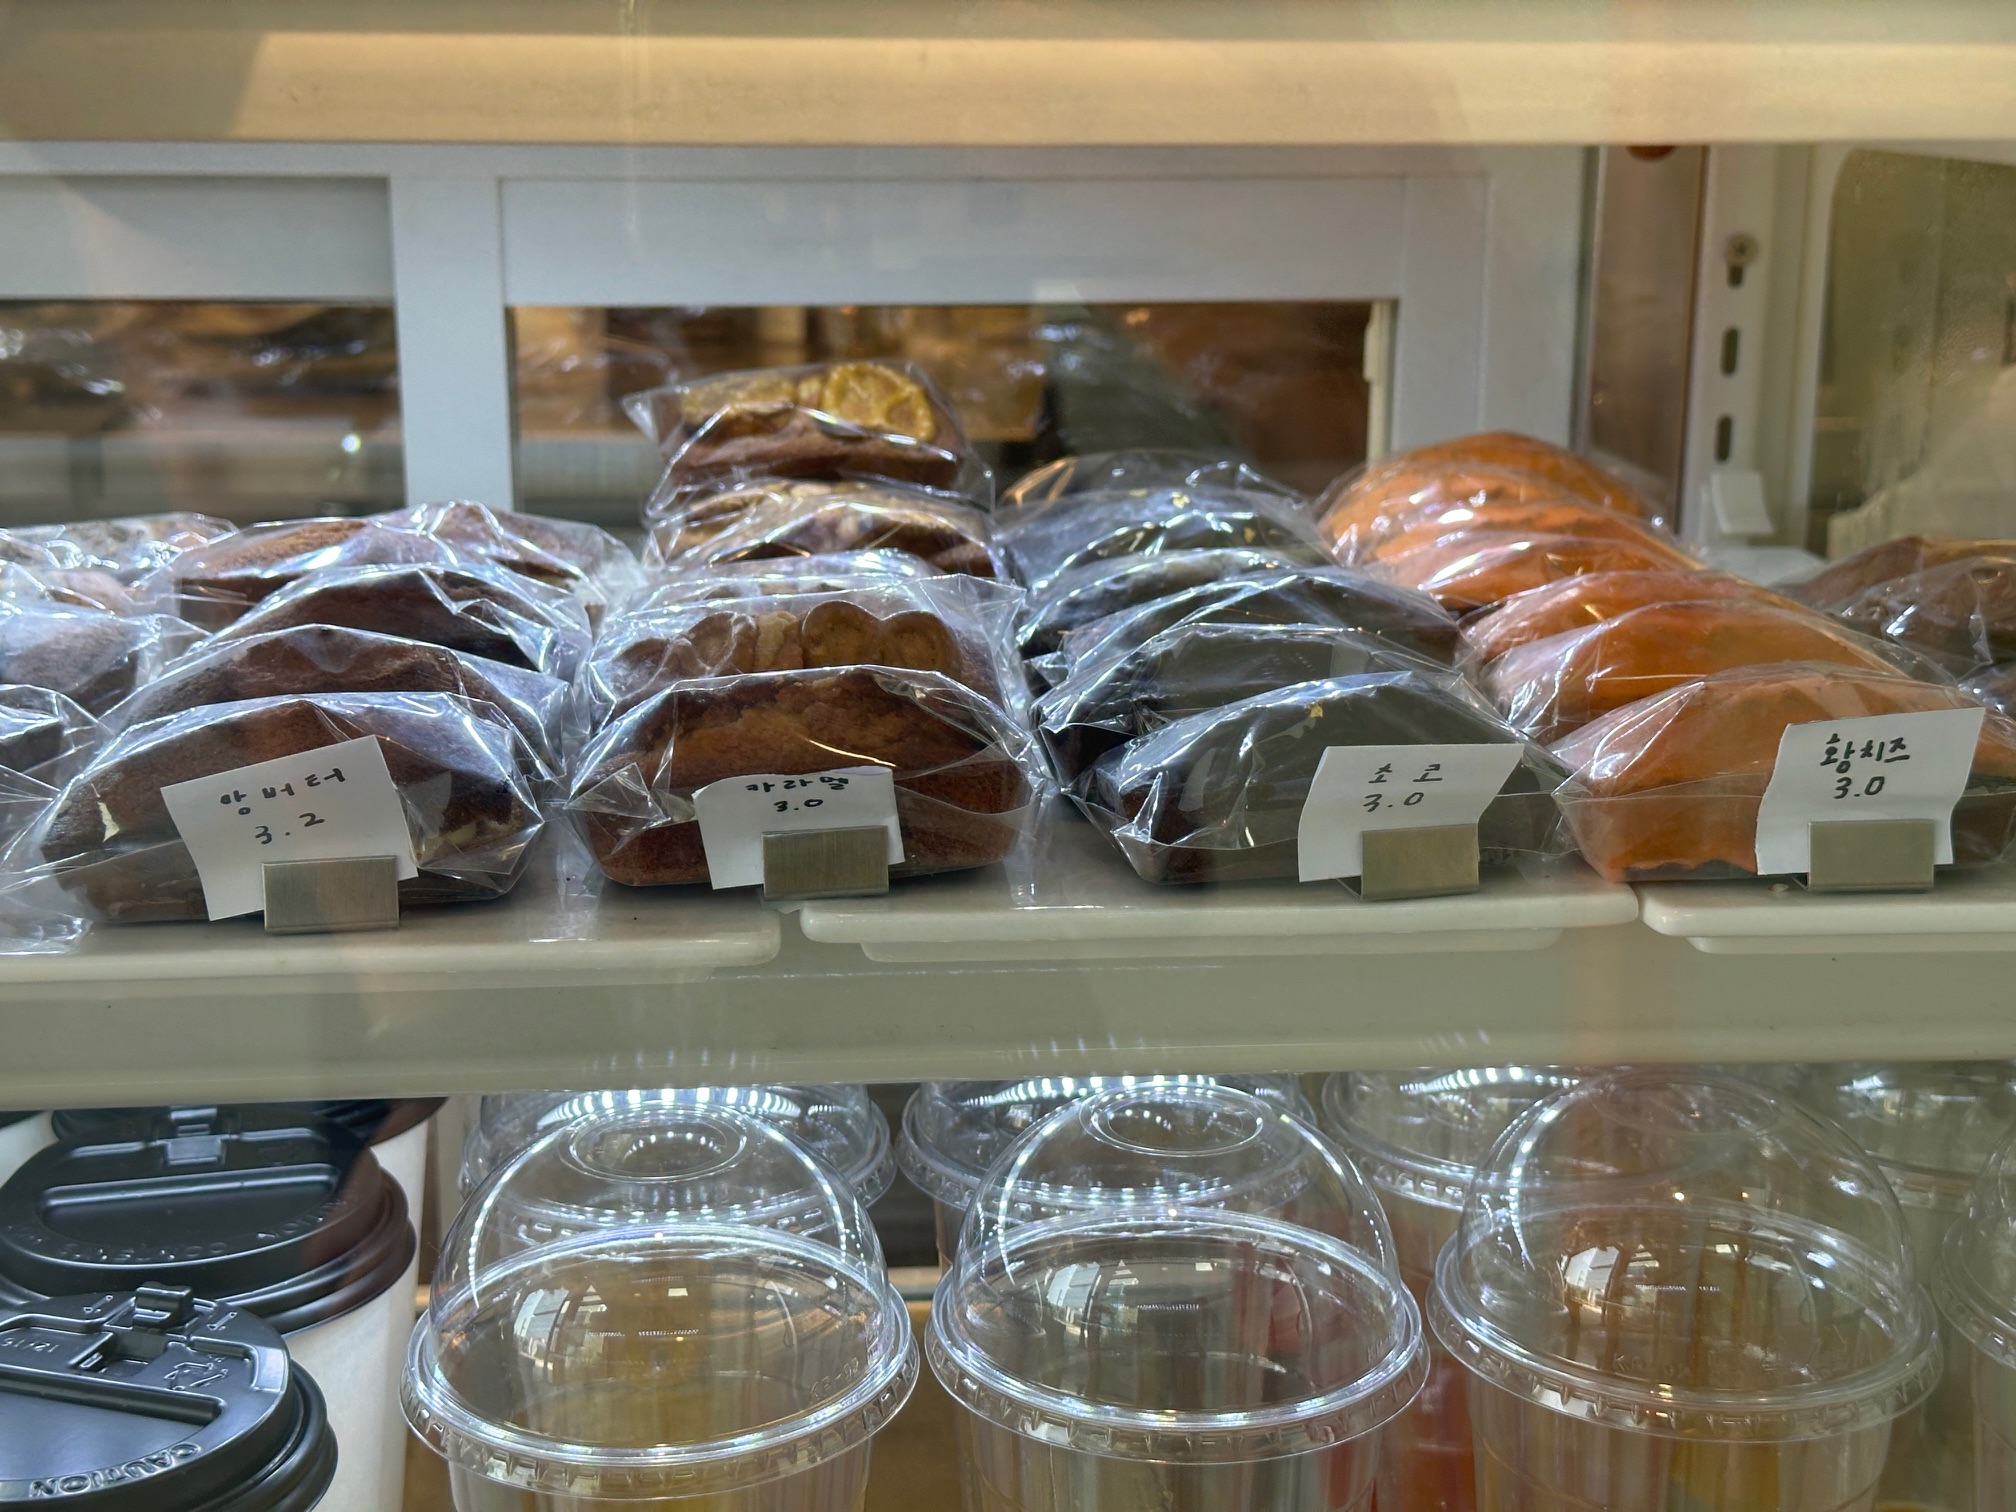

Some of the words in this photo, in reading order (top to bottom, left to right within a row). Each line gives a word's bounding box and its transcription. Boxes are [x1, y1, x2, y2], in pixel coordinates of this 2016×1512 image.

[1819, 732, 1911, 774] 황치즈
[744, 776, 849, 792] 카라멜
[1367, 762, 1443, 784] 초코
[219, 767, 346, 816] 앙버터
[1832, 776, 1886, 800] 3.0
[772, 798, 824, 813] 3.0
[1362, 791, 1425, 813] 3.0
[254, 812, 326, 845] 3.2
[29, 1441, 202, 1499] CAUTION
